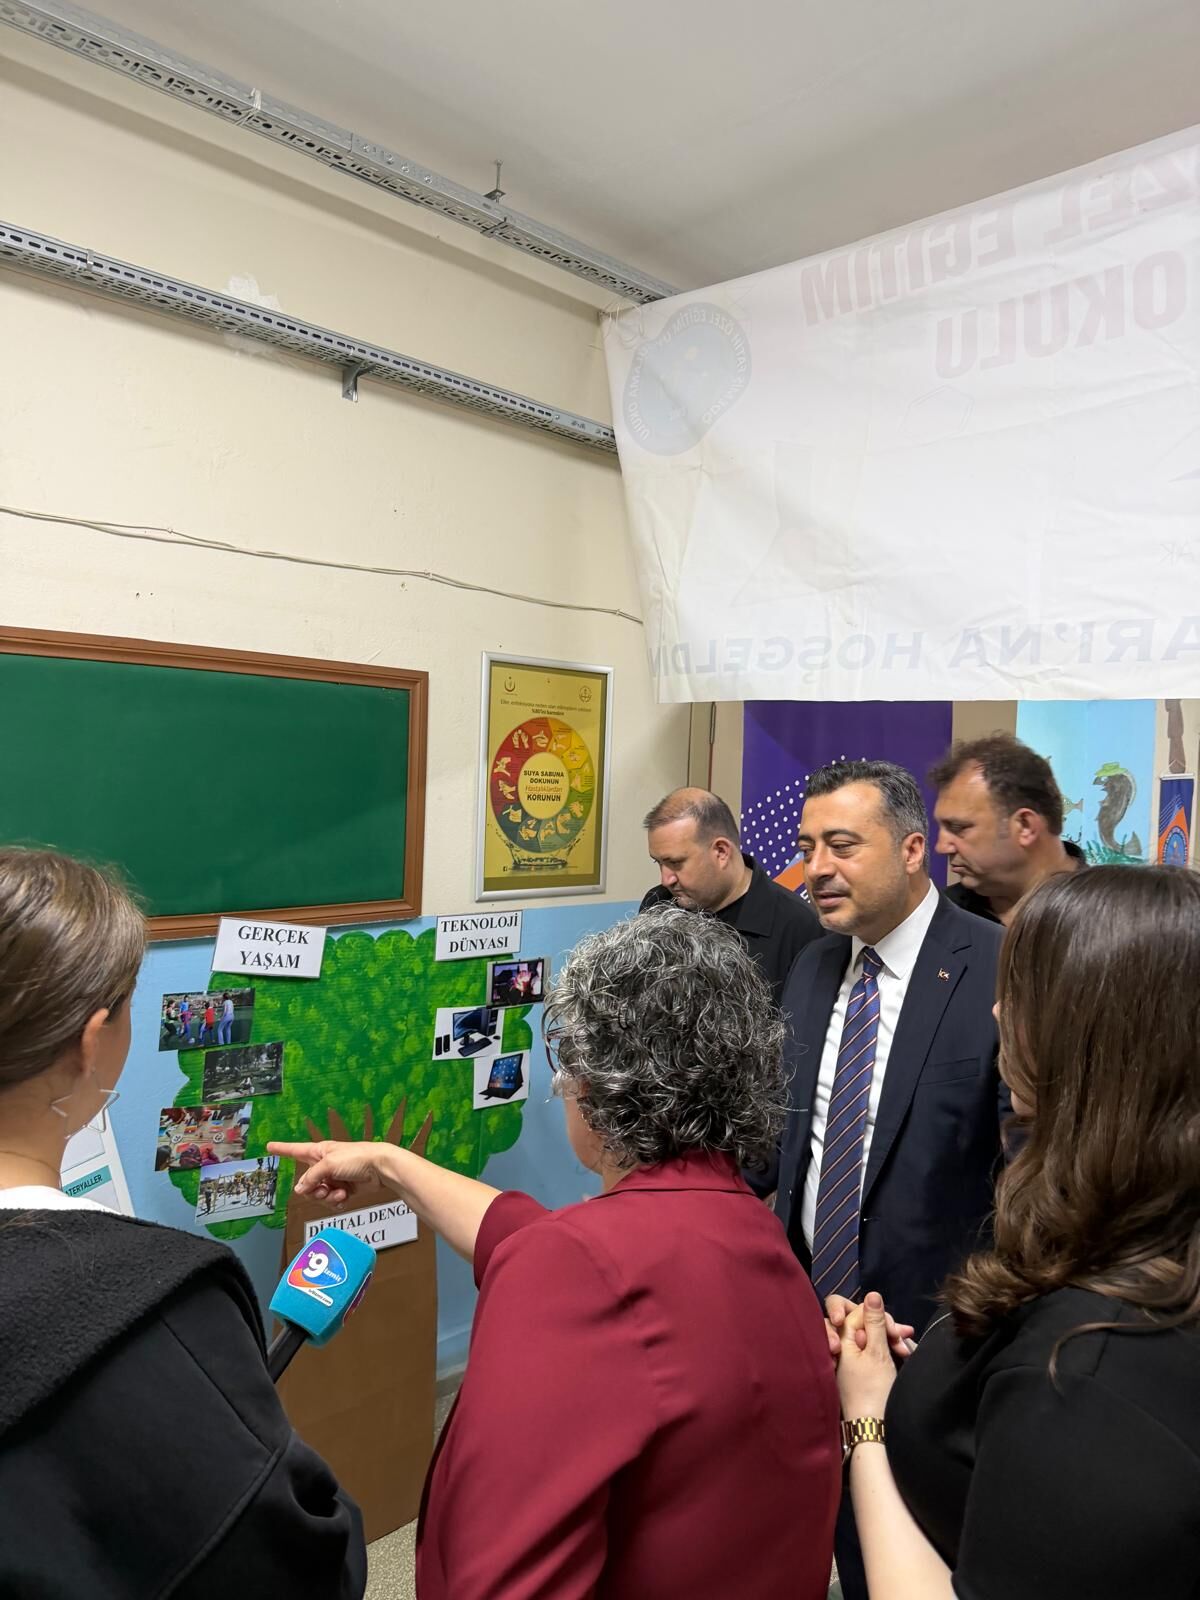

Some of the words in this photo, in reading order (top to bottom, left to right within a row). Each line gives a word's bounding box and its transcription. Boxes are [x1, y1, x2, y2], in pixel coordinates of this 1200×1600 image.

[527, 794, 561, 802] KORUNUN
[440, 912, 518, 933] TEKNOLOJİ
[238, 925, 310, 946] GERÇEK
[449, 936, 508, 953] DÜNYASI
[239, 950, 301, 970] YAŞAM
[64, 1174, 103, 1198] ATERYALLER
